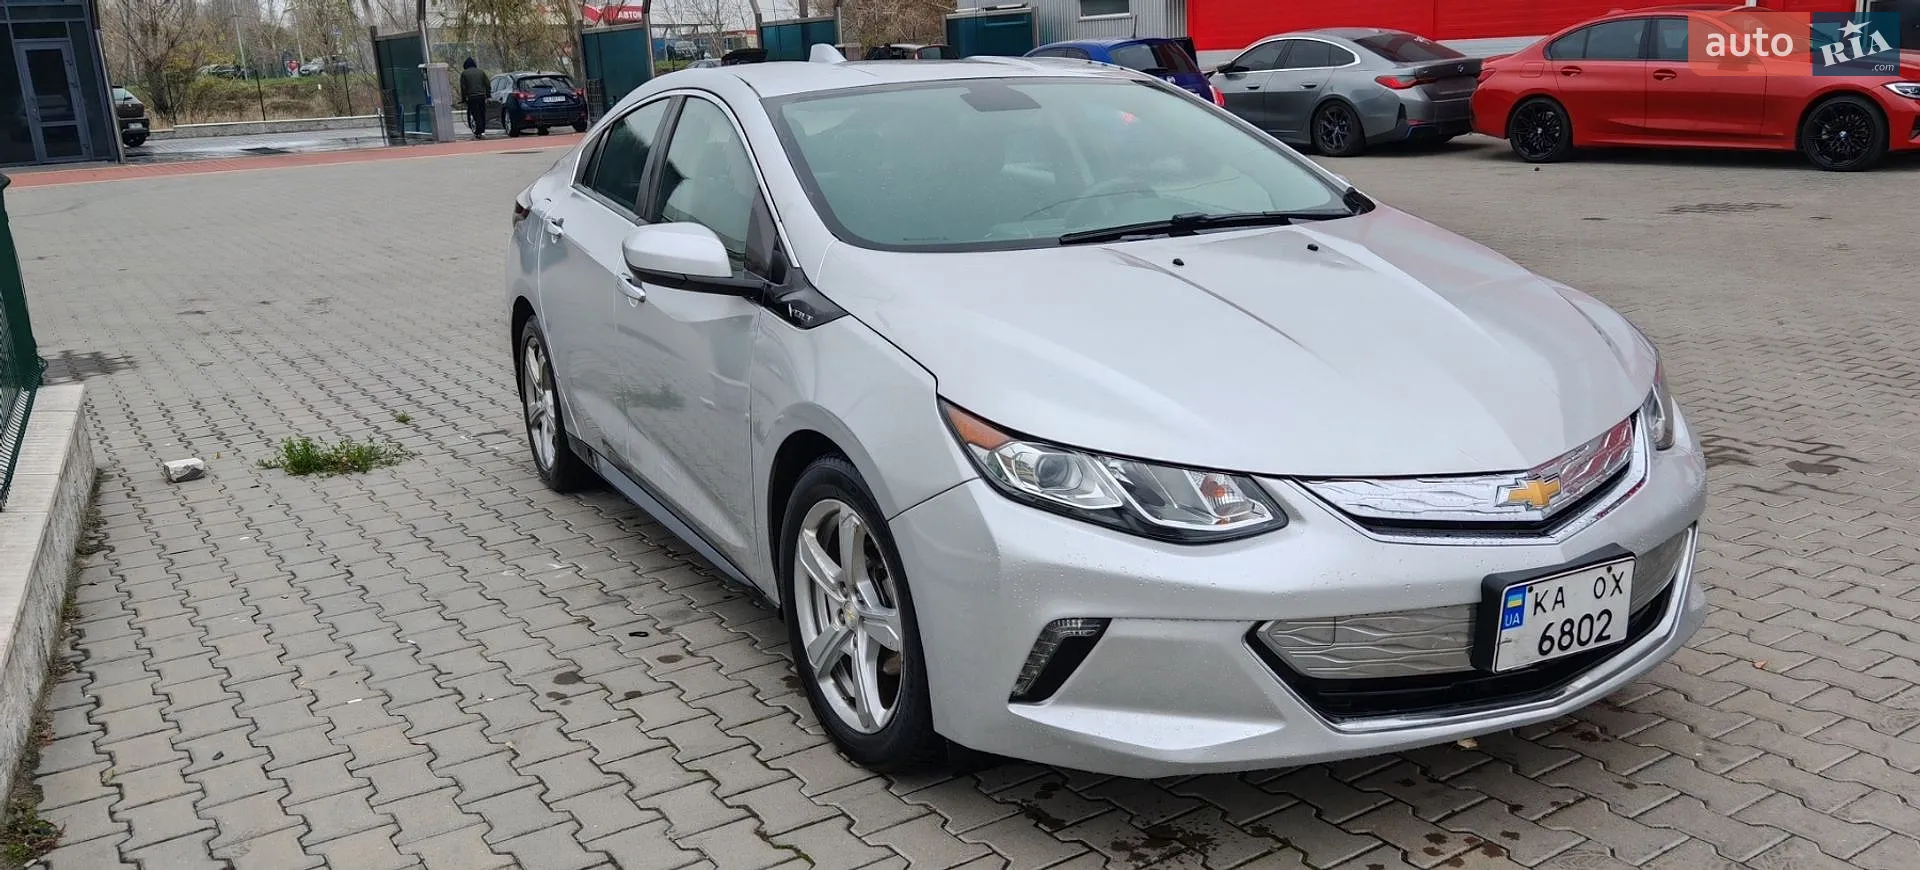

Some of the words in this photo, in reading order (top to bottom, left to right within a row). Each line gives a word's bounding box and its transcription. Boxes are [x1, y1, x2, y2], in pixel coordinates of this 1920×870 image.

[1533, 586, 1566, 616] KA
[1593, 571, 1625, 599] OX
[1505, 613, 1521, 627] UA
[1538, 608, 1613, 656] 6802
